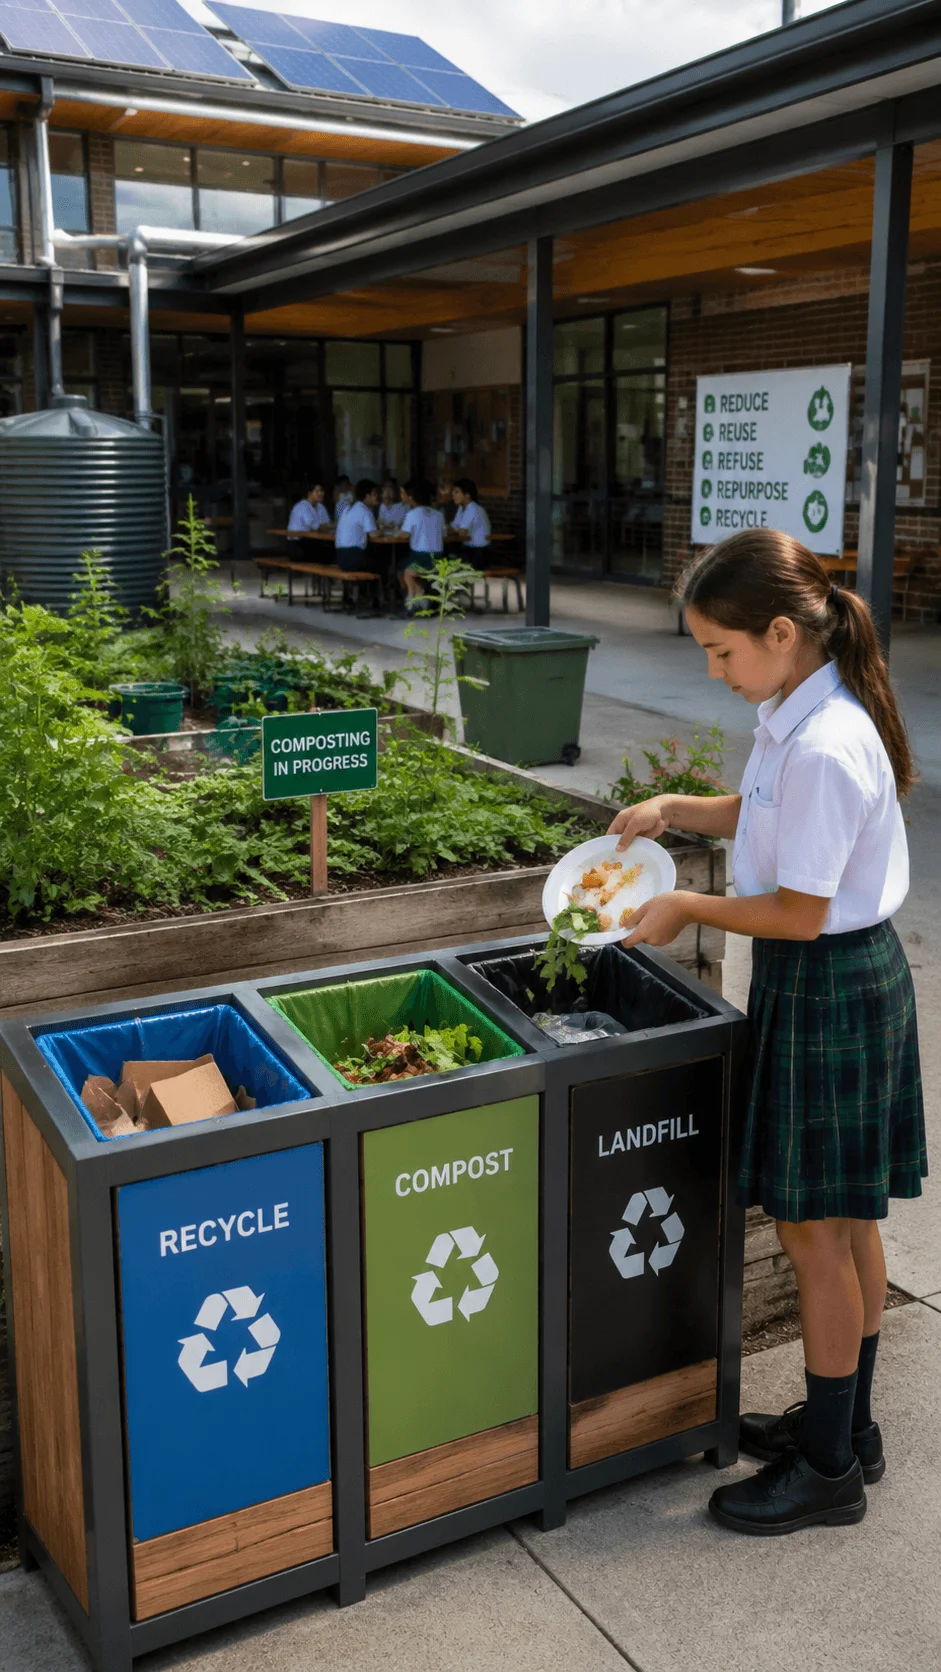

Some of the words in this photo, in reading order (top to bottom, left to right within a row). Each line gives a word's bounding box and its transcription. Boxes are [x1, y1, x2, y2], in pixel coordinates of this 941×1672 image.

[720, 392, 769, 413] REDUCE
[719, 422, 757, 442] REUSE
[718, 452, 764, 471] REFUSE
[717, 480, 789, 500] REPURPOSE
[716, 508, 769, 528] RECYCLE
[271, 731, 371, 754] COMPOSTING
[274, 761, 288, 776] IN
[293, 753, 368, 775] PROGRESS
[598, 1113, 699, 1157] LANDFILL
[394, 1148, 514, 1197] COMPOST
[159, 1202, 290, 1257] RECYCLE
